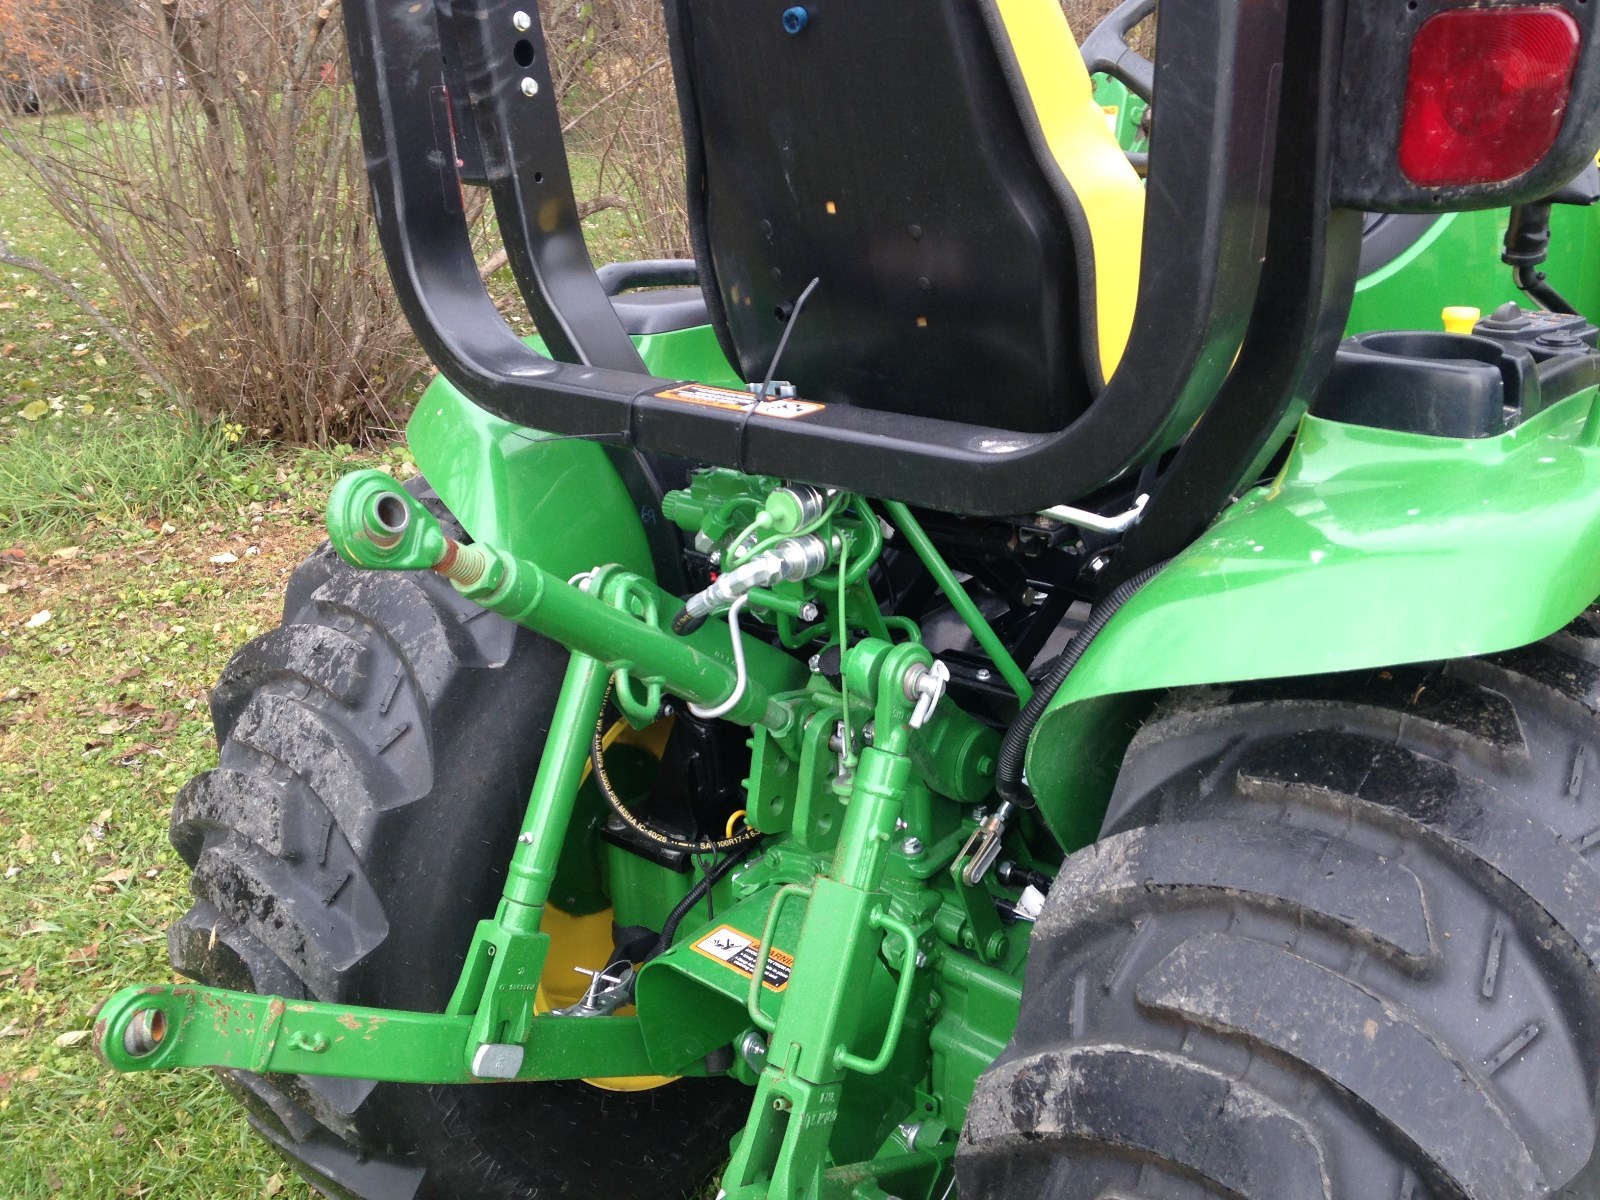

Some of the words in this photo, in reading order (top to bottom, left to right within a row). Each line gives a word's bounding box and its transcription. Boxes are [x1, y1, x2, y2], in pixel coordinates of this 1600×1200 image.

[617, 804, 638, 826] MSHA
[637, 822, 668, 843] IC-40/26
[716, 833, 750, 848] 100R17-4
